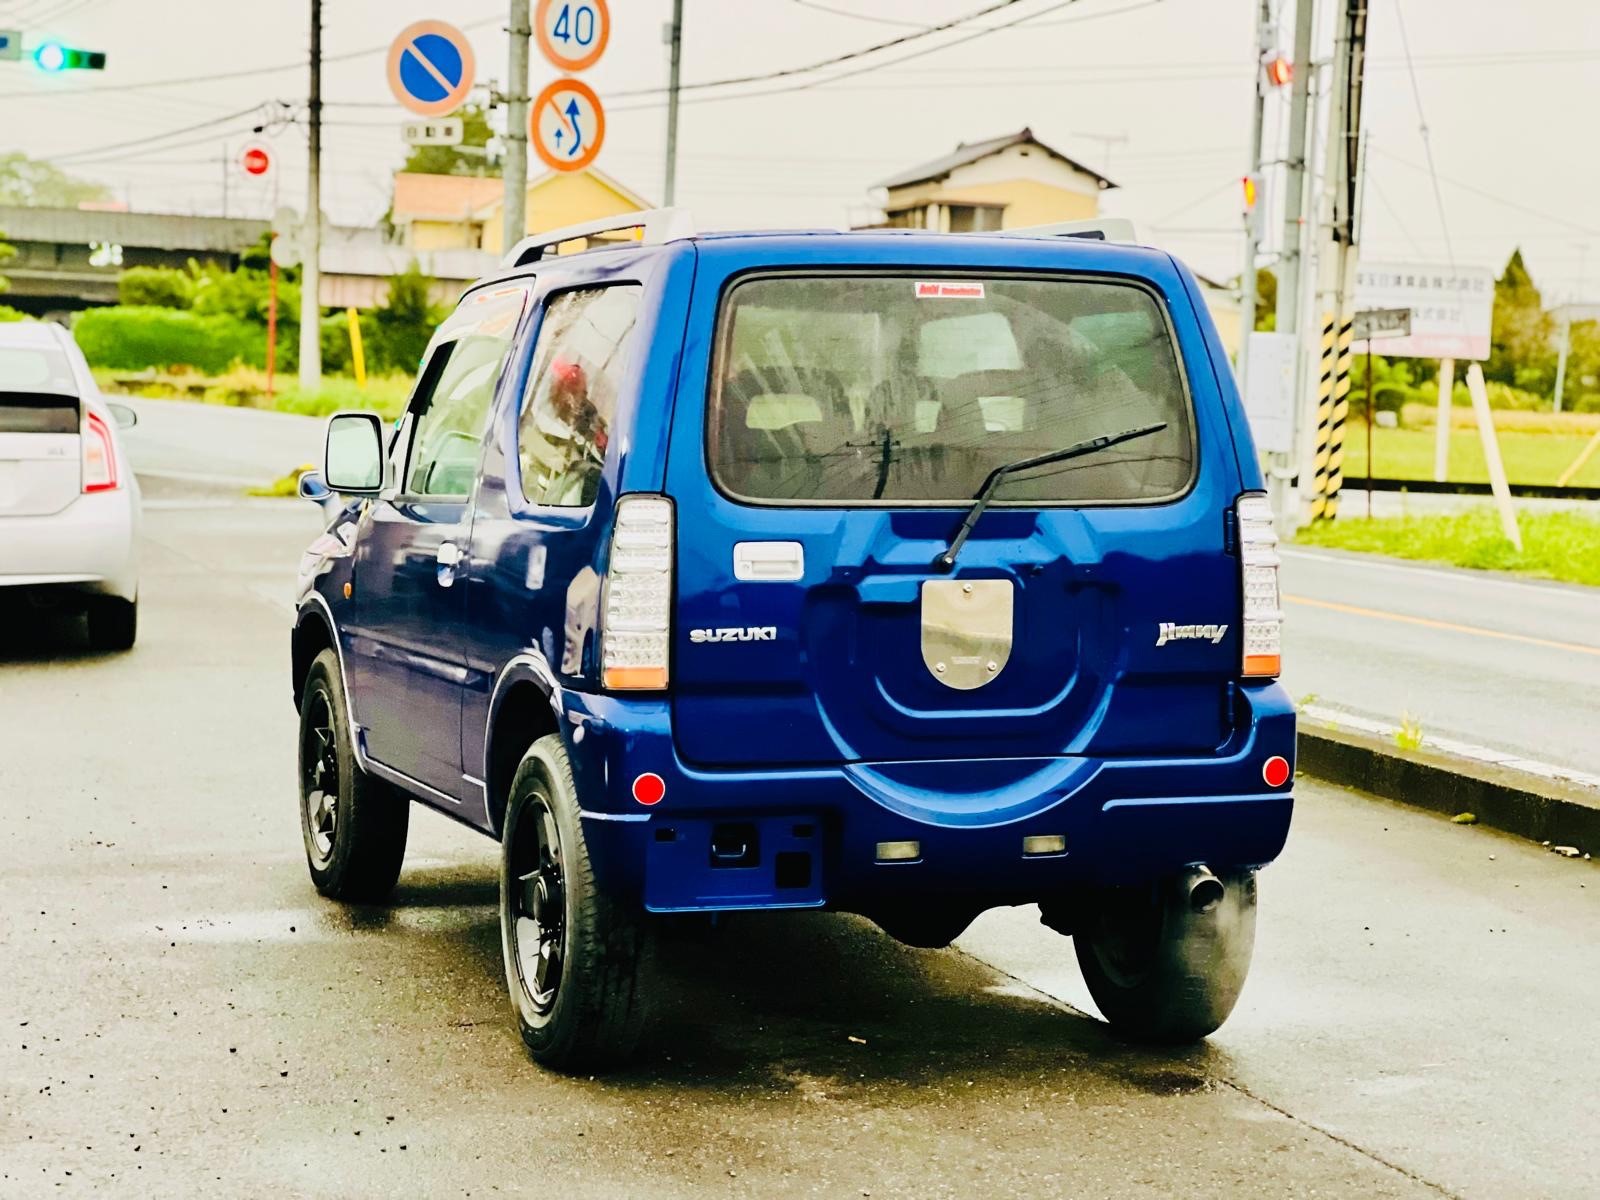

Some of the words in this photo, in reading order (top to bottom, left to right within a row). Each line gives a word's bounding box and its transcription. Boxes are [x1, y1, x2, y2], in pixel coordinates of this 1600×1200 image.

[553, 4, 594, 46] 40
[689, 626, 777, 643] SUZUKI
[1155, 622, 1229, 647] Jimny
